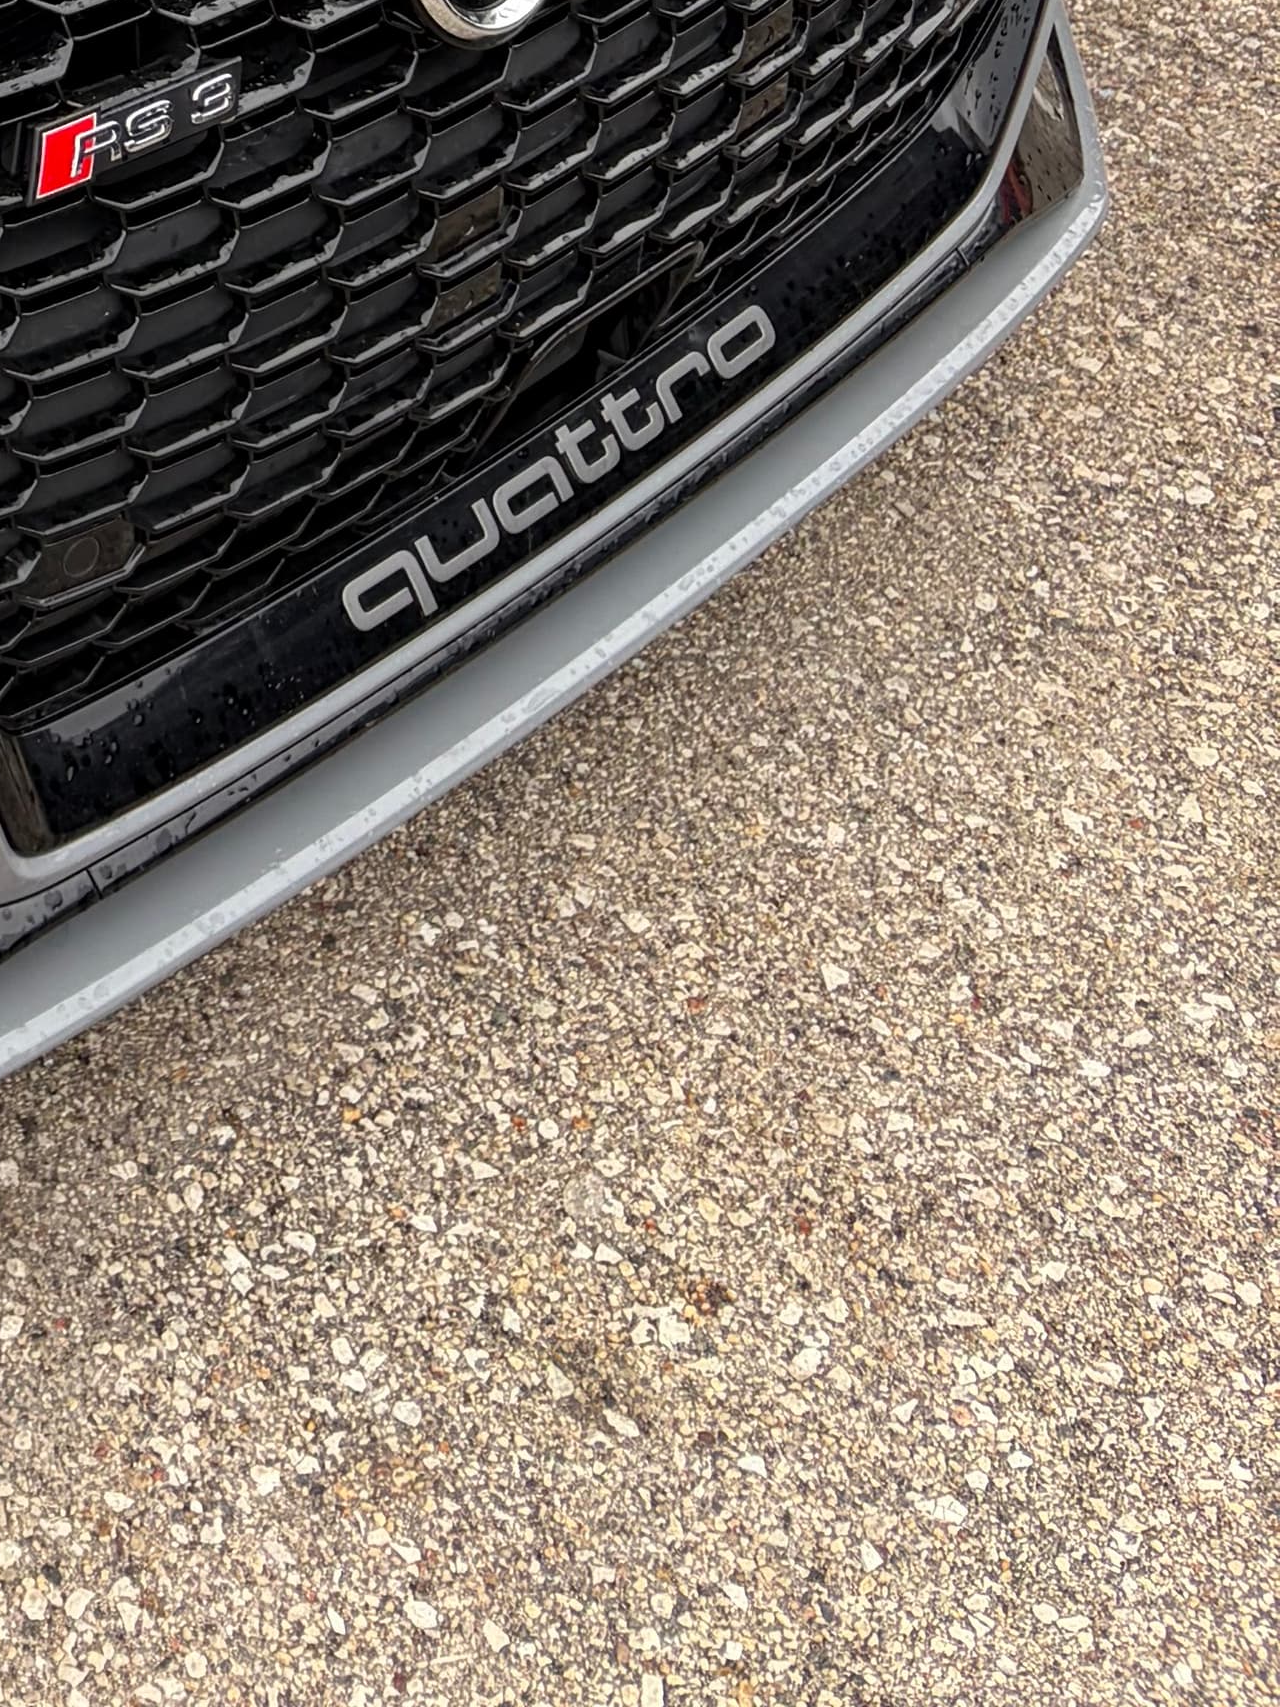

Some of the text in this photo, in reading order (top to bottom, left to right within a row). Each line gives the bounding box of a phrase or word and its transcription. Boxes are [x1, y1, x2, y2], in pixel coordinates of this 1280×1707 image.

[62, 73, 236, 184] RS 3
[342, 304, 776, 631] quattro
